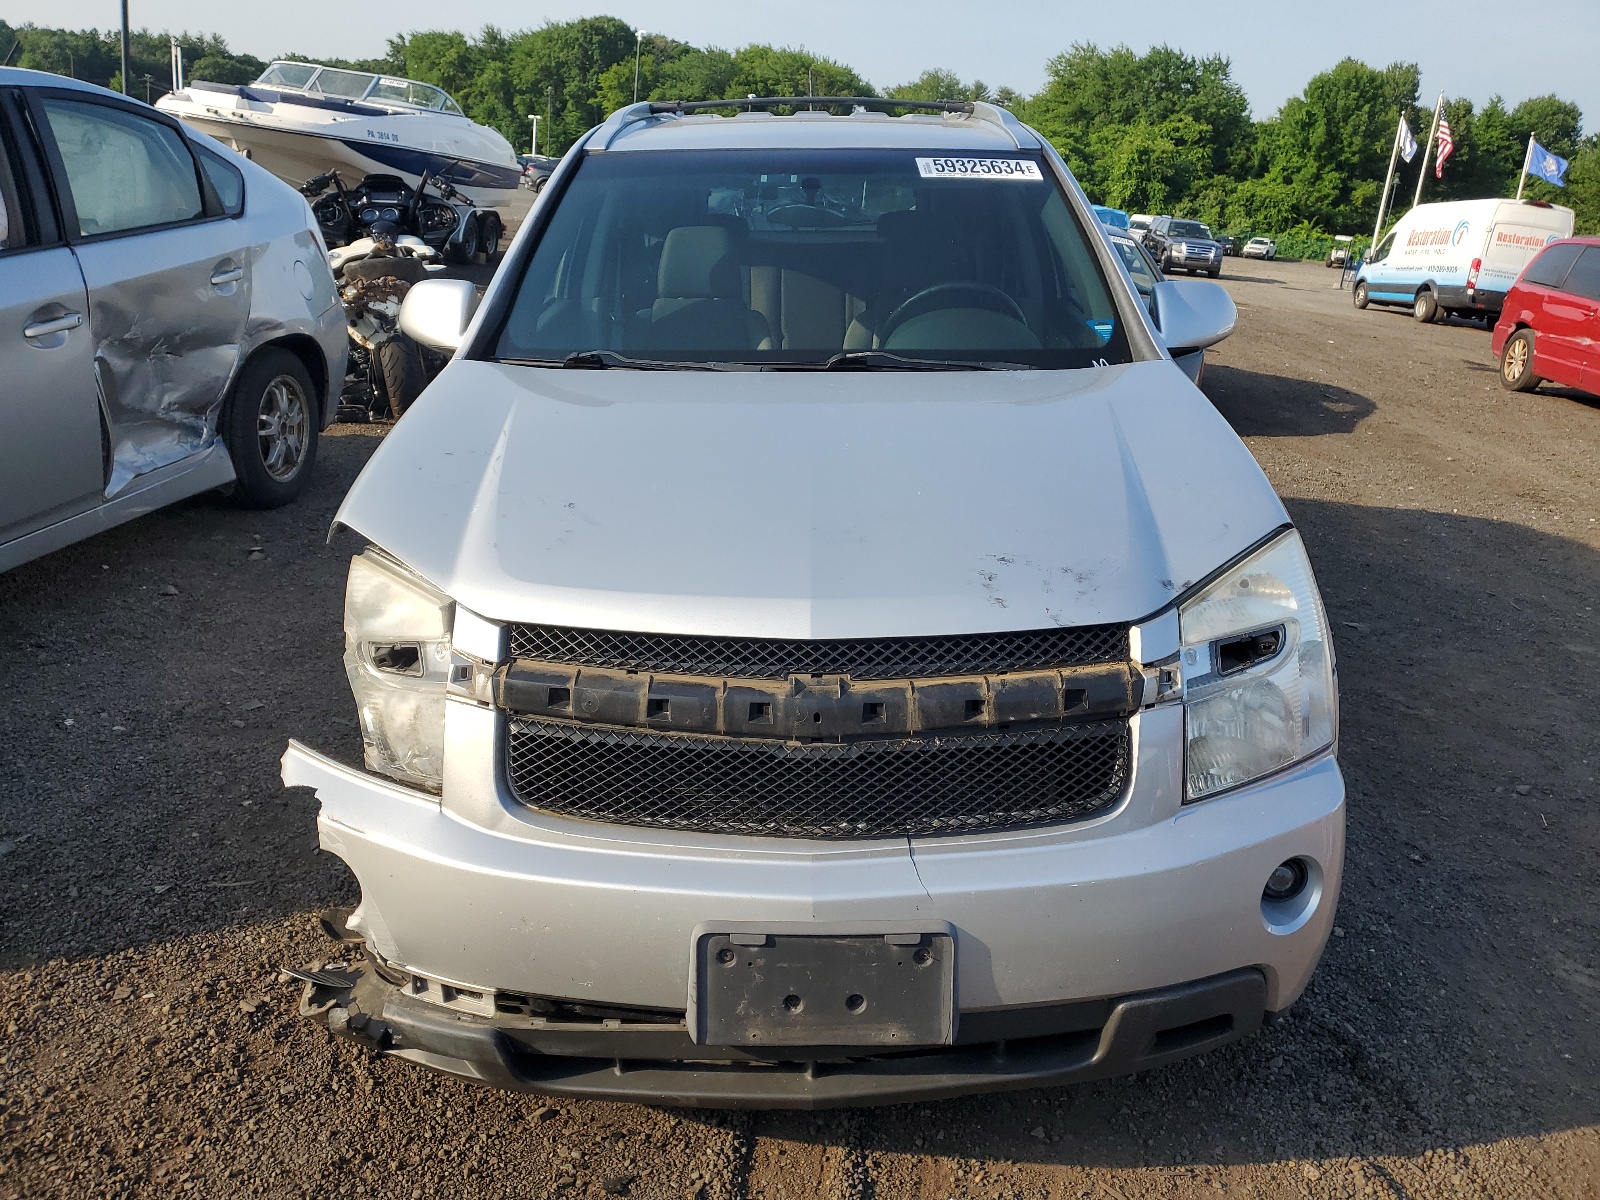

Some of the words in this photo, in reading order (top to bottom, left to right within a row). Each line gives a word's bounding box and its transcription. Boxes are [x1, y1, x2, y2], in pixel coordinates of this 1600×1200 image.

[932, 159, 1026, 175] 59325634
[1026, 165, 1035, 174] E
[1406, 228, 1452, 246] Restoration
[1496, 232, 1545, 247] Restoration
